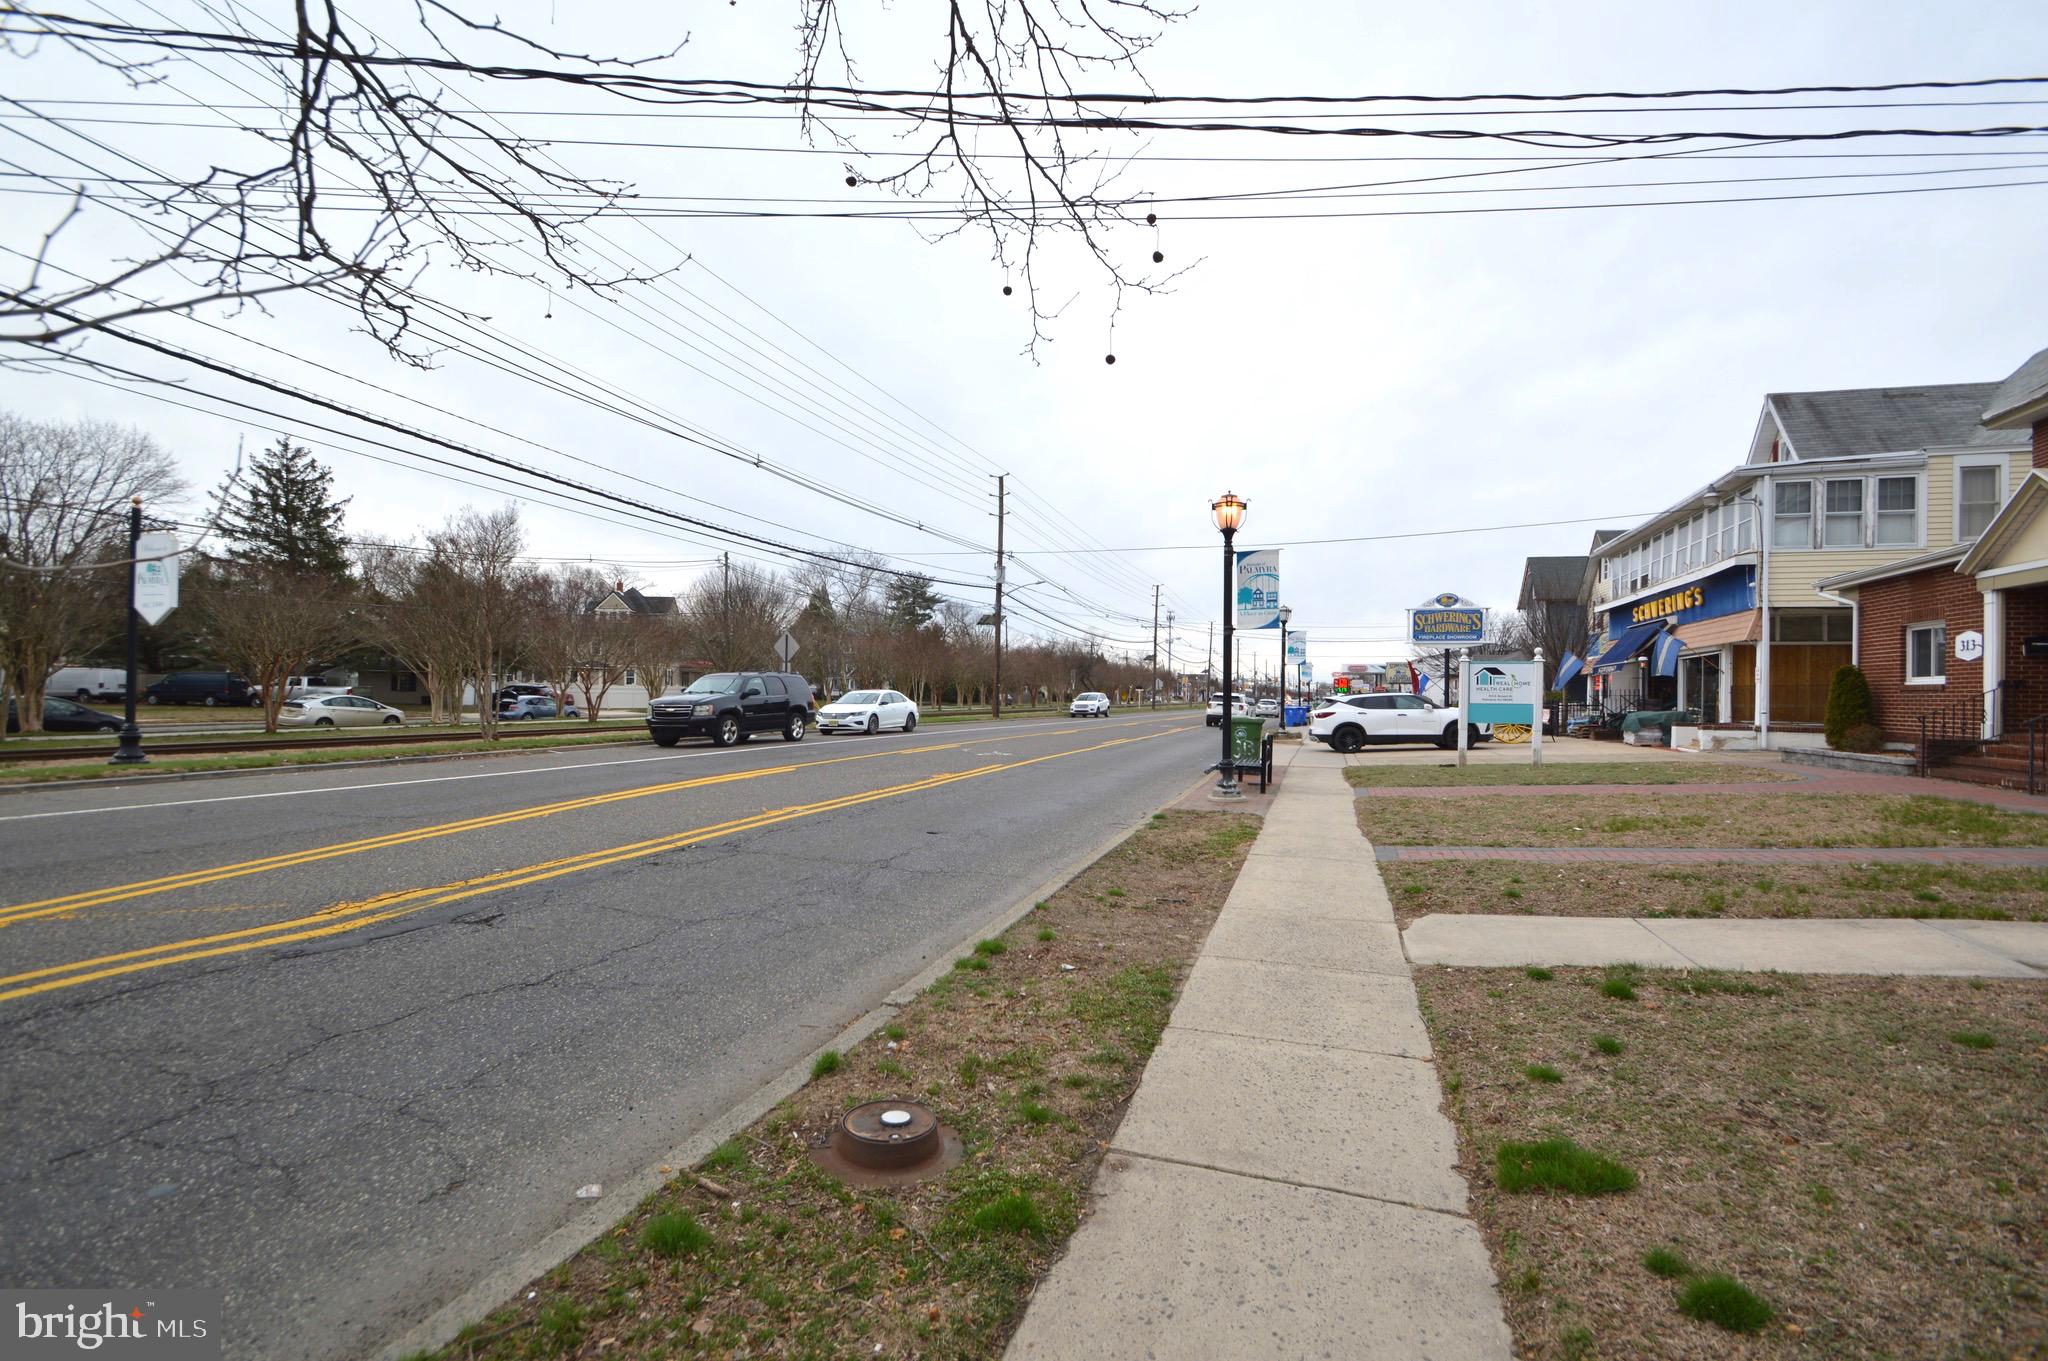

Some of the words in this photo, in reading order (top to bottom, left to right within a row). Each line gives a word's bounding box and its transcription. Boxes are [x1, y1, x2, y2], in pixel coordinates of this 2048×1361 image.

[1239, 565, 1278, 574] PALMYRA
[1633, 587, 1703, 622] SCHWERING'S
[1415, 612, 1481, 630] SCHWERING'S
[1424, 623, 1471, 632] HARDWARE
[1960, 640, 1976, 651] 313
